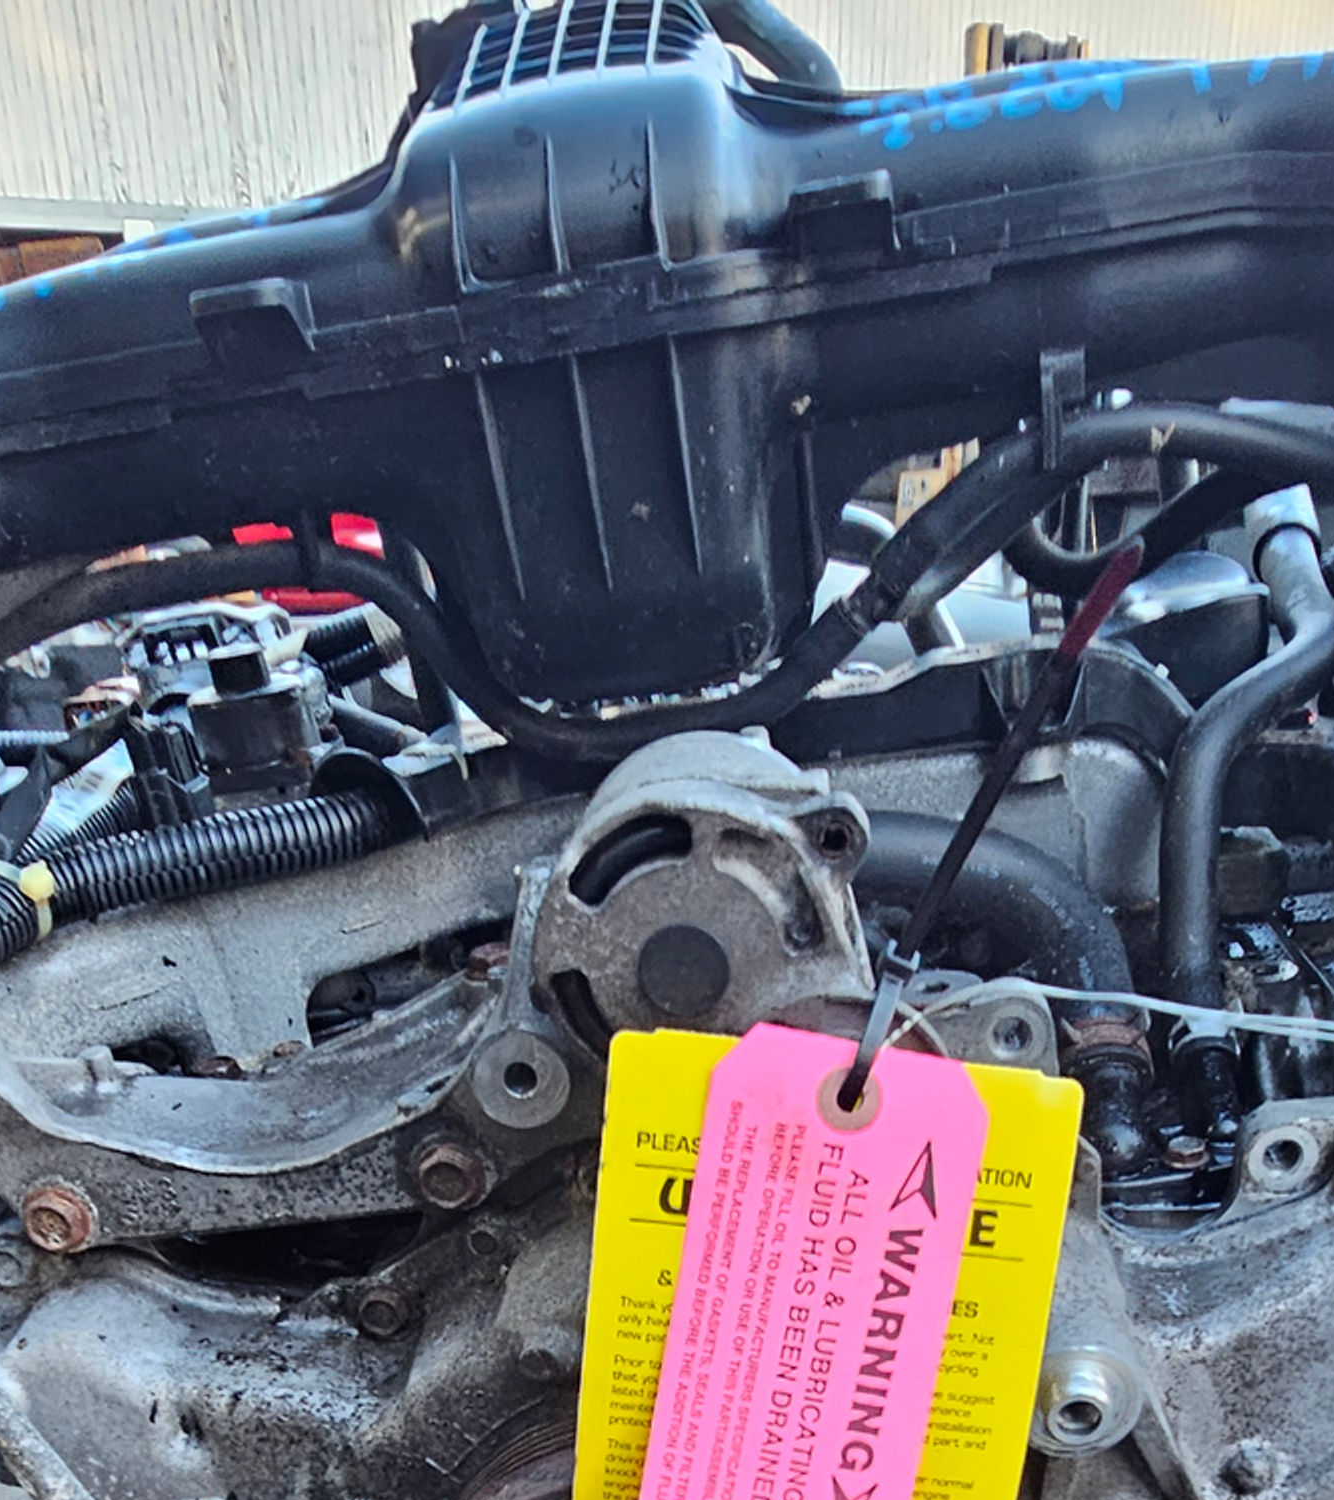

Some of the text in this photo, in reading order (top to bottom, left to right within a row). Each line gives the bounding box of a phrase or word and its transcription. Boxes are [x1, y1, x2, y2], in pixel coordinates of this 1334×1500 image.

[720, 1100, 741, 1163] SHOULD
[741, 1125, 757, 1153] THE
[766, 1123, 786, 1183] BEFORE
[785, 1124, 805, 1183] PLEASE
[636, 1131, 1032, 1188] PLEAS TION
[715, 1168, 729, 1187] BE
[778, 1188, 792, 1217] FILL
[808, 1142, 842, 1227] FLUID
[840, 1170, 869, 1226] ALL
[719, 1159, 750, 1268] REPLACEMENT
[748, 1188, 773, 1273] OPERATION
[771, 1222, 786, 1246] OIL
[697, 1192, 724, 1283] PERFORMED
[767, 1251, 780, 1270] TO
[829, 1235, 856, 1282] OIL
[657, 1268, 672, 1286] &
[714, 1273, 728, 1292] OF
[793, 1237, 824, 1296] HAS
[742, 1284, 755, 1299] OR
[823, 1291, 845, 1309] &
[616, 1329, 642, 1339] new
[617, 1313, 641, 1325] only
[645, 1315, 669, 1327] hav
[949, 1349, 976, 1359] over
[619, 1295, 655, 1309] Thank
[972, 1332, 994, 1345] Not
[685, 1288, 705, 1346] BEFORE
[735, 1303, 751, 1331] USE
[741, 1275, 775, 1401] MANUFACTURERS
[613, 1354, 644, 1367] Prior
[679, 1351, 694, 1378] THE
[731, 1336, 744, 1355] OF
[777, 1305, 808, 1380] BEEN
[838, 1228, 925, 1473] WARNING
[690, 1372, 708, 1418] SEALS
[724, 1361, 739, 1390] THIS
[666, 1382, 687, 1447] ADDITION
[683, 1422, 699, 1452] AND
[606, 1438, 632, 1450] This
[931, 1476, 974, 1489] normal
[661, 1452, 675, 1470] OF
[933, 1436, 959, 1448] part
[963, 1438, 986, 1449] and
